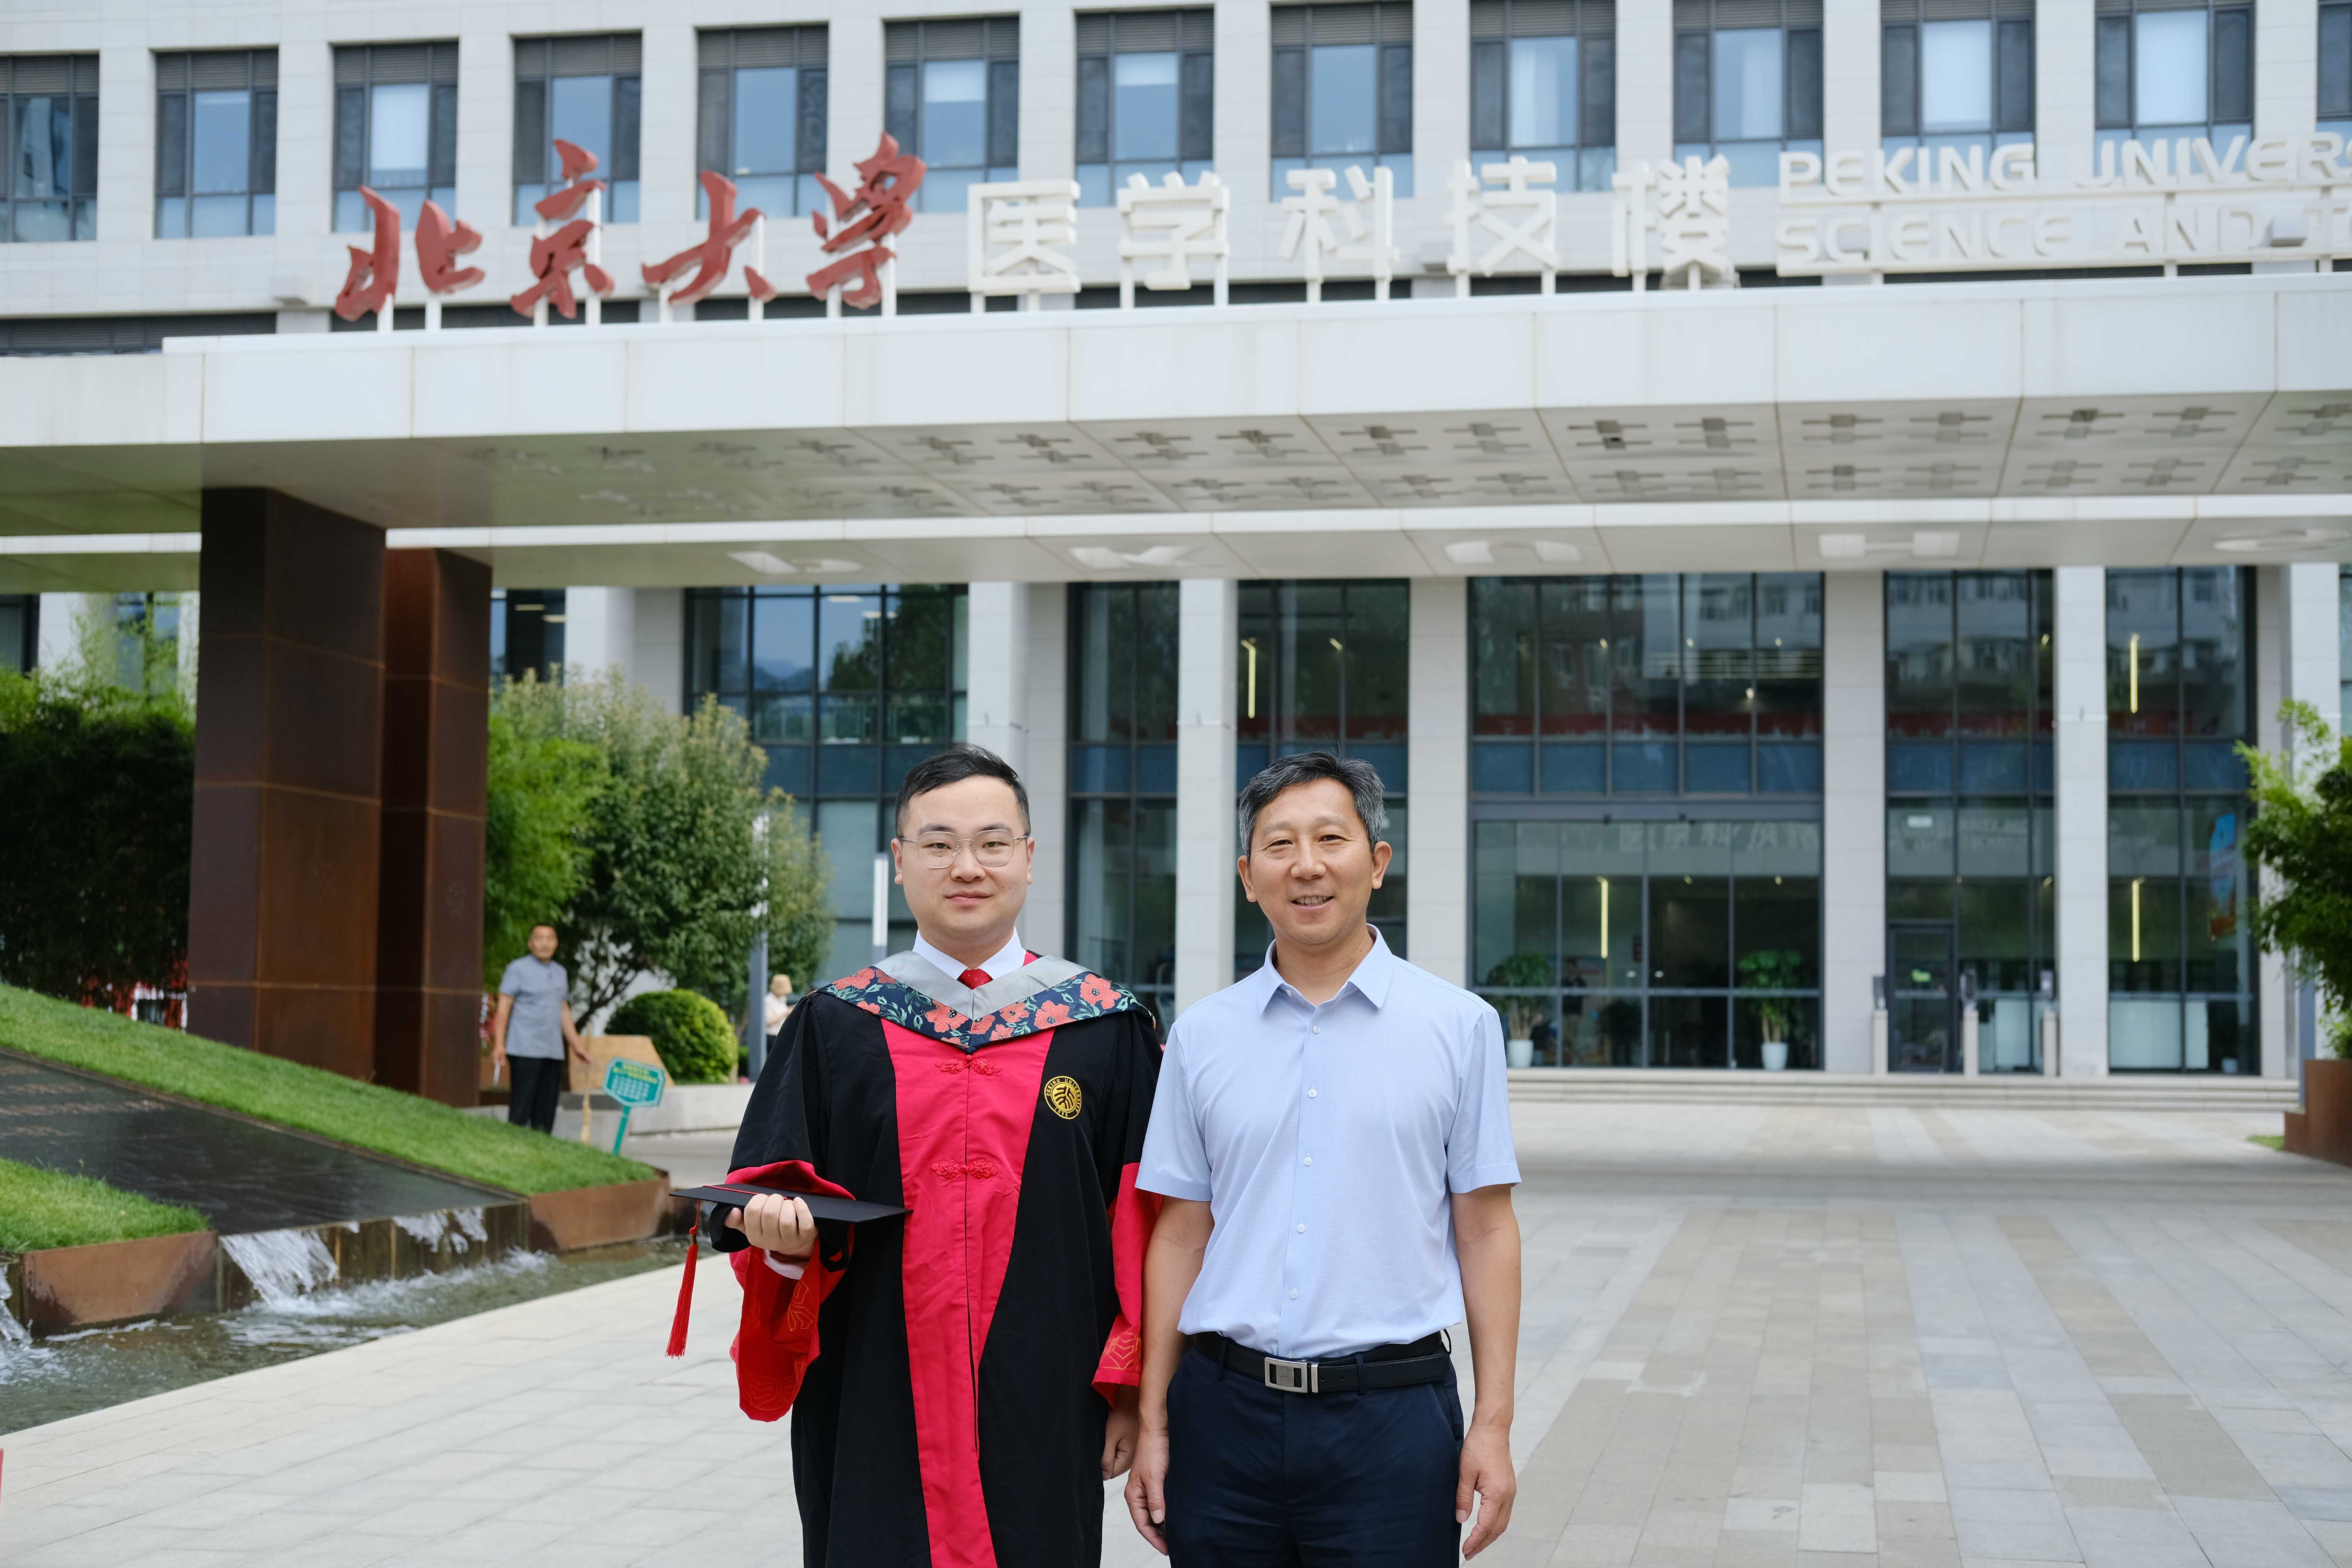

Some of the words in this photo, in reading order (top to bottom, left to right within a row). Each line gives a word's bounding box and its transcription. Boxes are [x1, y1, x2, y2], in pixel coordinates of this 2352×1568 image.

[1778, 142, 2035, 196] PEKING
[2074, 130, 2352, 188] UNIVER
[334, 131, 928, 322] 北京大学
[968, 155, 1731, 294] 医学科技楼
[1776, 211, 2071, 263] SCIENCE
[2117, 204, 2265, 253] AND
[2302, 199, 2352, 250] T
[1046, 1078, 1060, 1096] PEKING
[1065, 1078, 1081, 1113] UNIVERSITY
